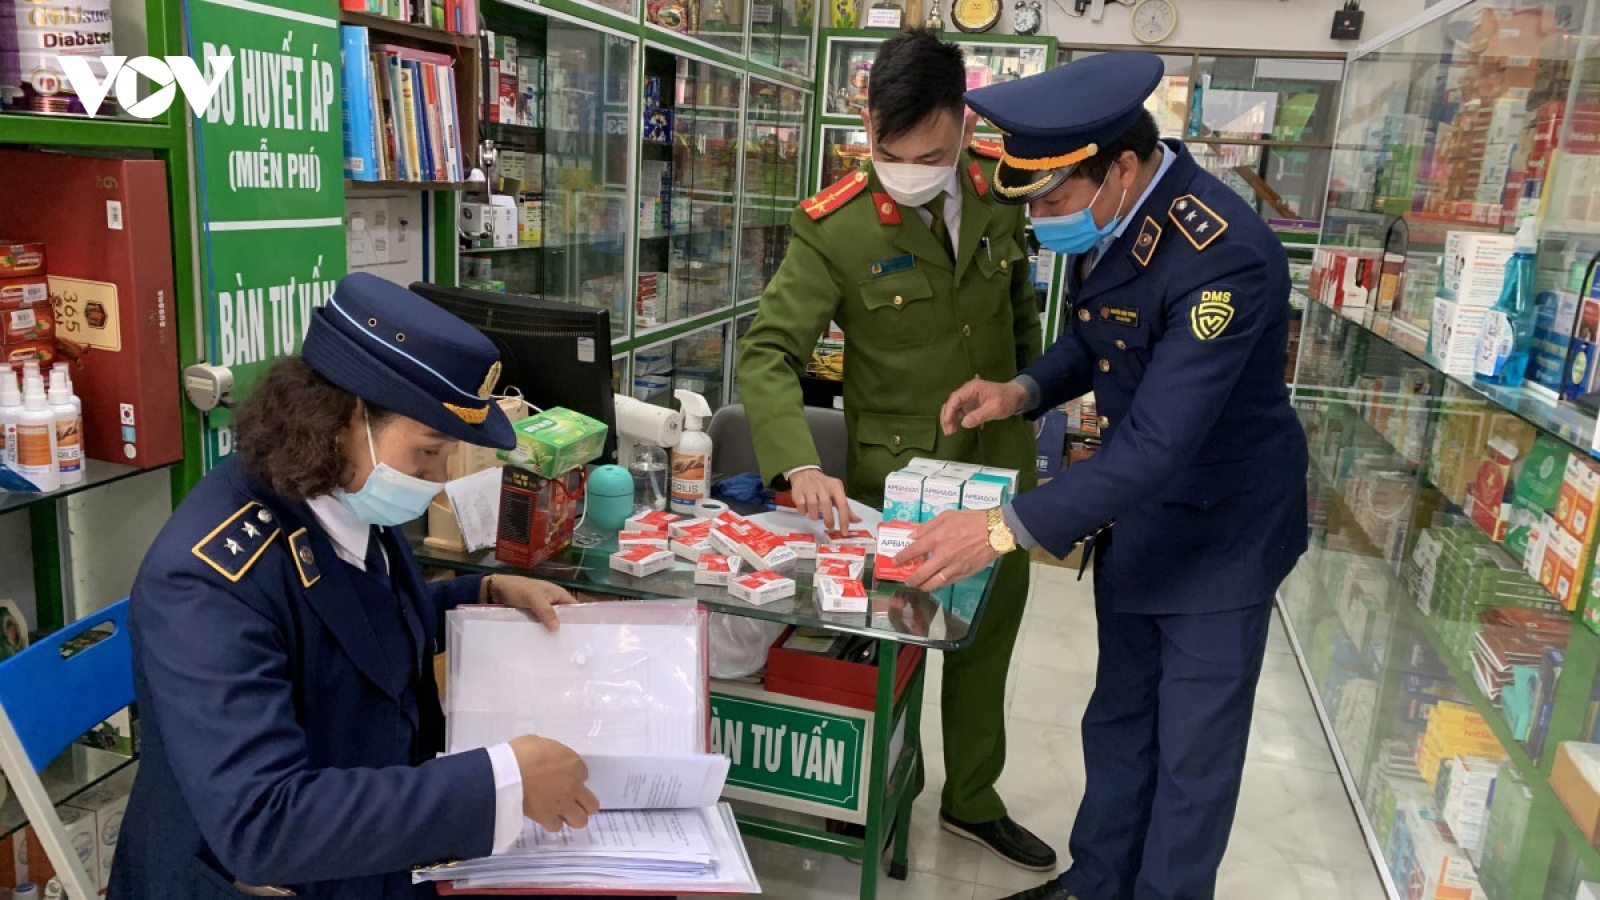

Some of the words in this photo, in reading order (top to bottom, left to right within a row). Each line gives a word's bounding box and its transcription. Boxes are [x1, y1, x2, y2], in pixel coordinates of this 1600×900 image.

[240, 30, 304, 131] HUYẾT
[310, 43, 334, 133] ÁP
[228, 137, 283, 192] (MIỄN
[287, 146, 321, 193] PHÍ)
[218, 272, 266, 368] BÀN
[268, 276, 296, 357] TƯ
[1201, 291, 1232, 303] DMS
[710, 706, 744, 766] ÀN
[751, 723, 787, 773] TƯ
[791, 720, 845, 786] VẤN
